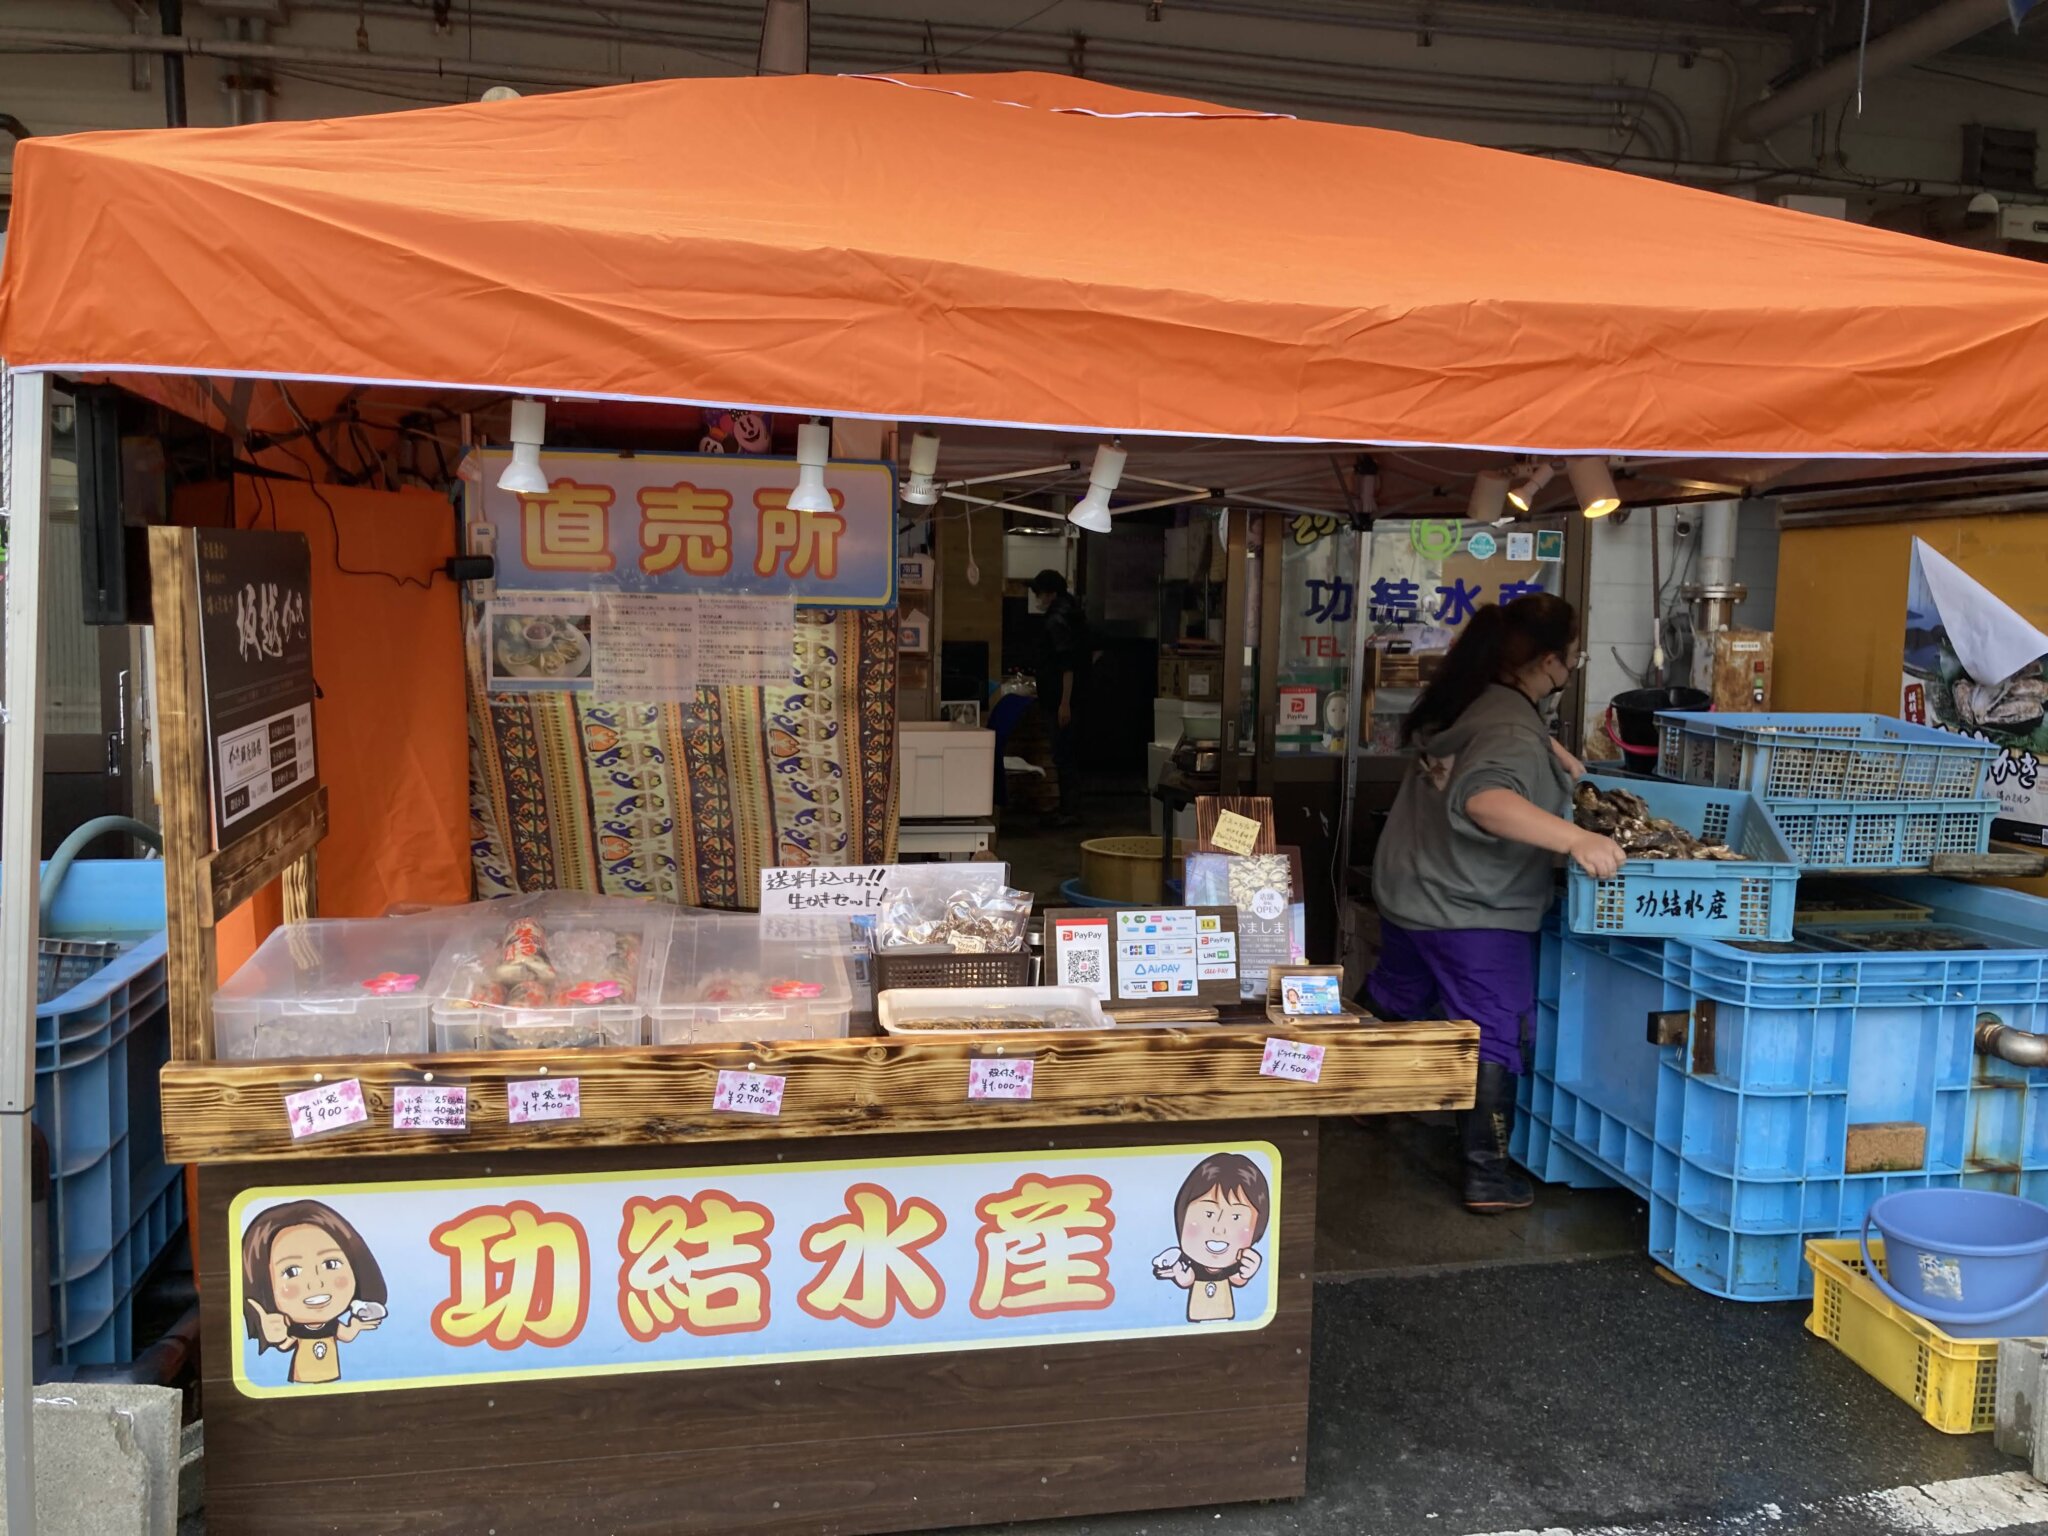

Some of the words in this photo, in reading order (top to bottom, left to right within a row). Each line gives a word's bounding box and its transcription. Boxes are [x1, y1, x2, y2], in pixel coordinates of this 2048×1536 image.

[516, 478, 847, 580] 直売所
[1300, 636, 1345, 658] TEL
[1287, 713, 1308, 721] PayPay
[1985, 747, 2039, 790] かき
[765, 868, 886, 890] 送料込み!!
[788, 888, 888, 910] 生かきセット!
[1256, 905, 1281, 914] OPEN
[1635, 889, 1728, 920] 功結水産
[1074, 931, 1102, 940] PayPay
[1147, 964, 1181, 973] AirPAY
[531, 1088, 556, 1101] 中袋
[738, 1082, 760, 1093] 大袋
[429, 1173, 1117, 1351] 功結水産
